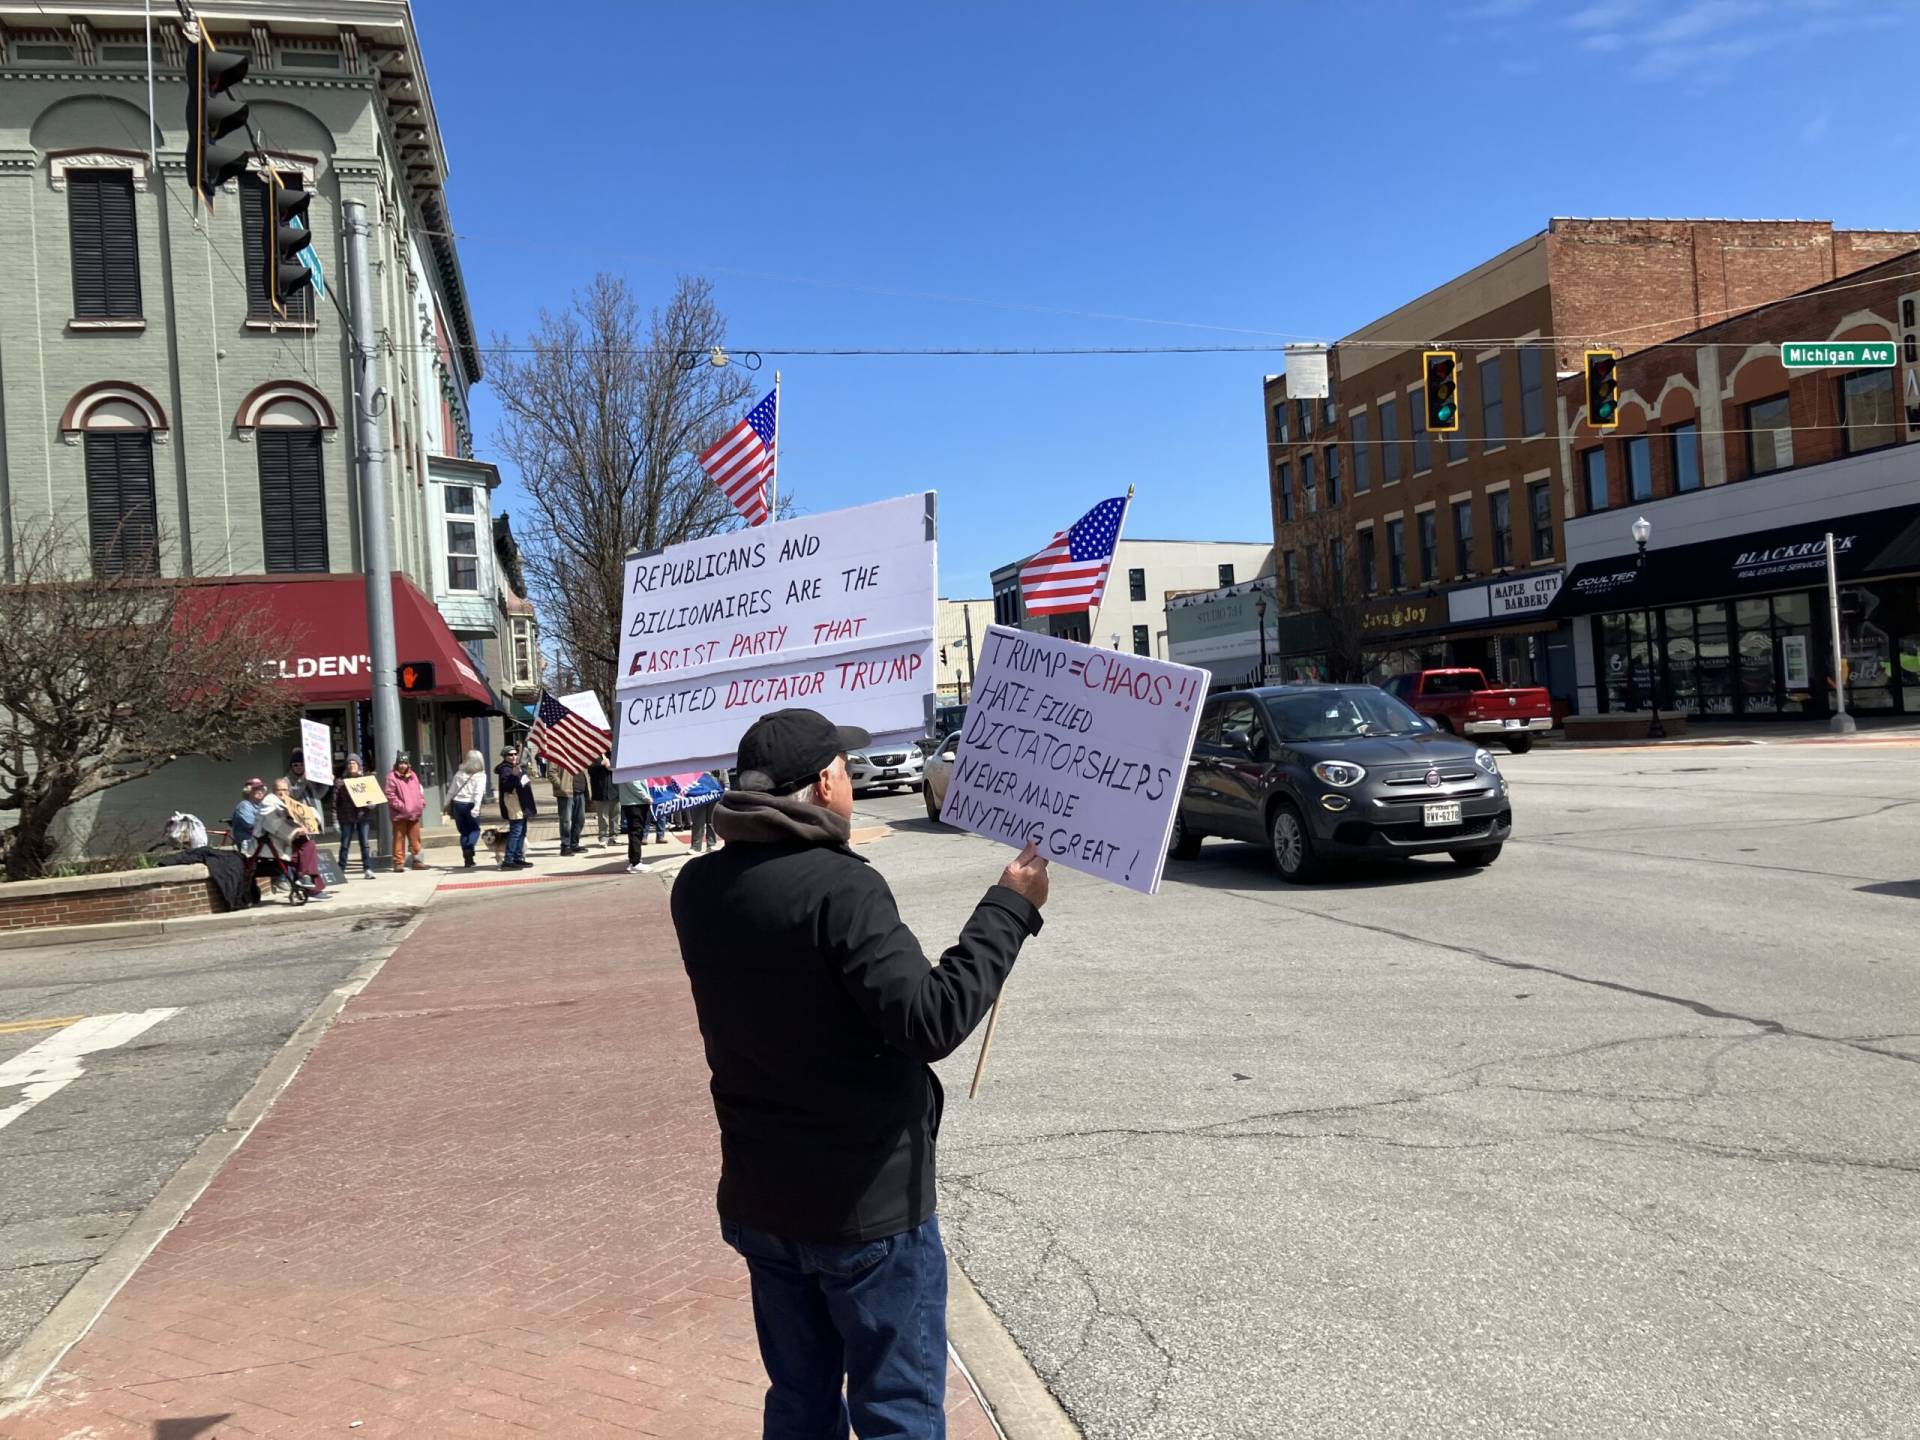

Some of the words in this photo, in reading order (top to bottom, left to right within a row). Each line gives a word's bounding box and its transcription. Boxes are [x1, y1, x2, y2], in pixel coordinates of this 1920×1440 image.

[1790, 348, 1854, 365] Michigan
[1862, 348, 1888, 361] Ave
[633, 543, 766, 594] REPUBLICANS
[779, 534, 820, 563] AND
[1495, 583, 1525, 598] MAPLE
[1534, 577, 1558, 592] CITY
[1577, 571, 1637, 587] COULTER
[629, 589, 772, 637] BILLIONAIRES
[785, 578, 822, 604] ARE
[842, 566, 880, 592] THE
[1362, 613, 1389, 629] Java
[1404, 607, 1427, 623] Joy
[1505, 593, 1549, 610] BARBERS
[629, 641, 720, 676] FASCIST
[729, 625, 788, 657] PARTY
[813, 618, 867, 645] THAT
[628, 686, 716, 726] CREATED
[724, 671, 825, 710] DICTATOR
[835, 653, 922, 691] TRUMP
[976, 675, 1035, 713] HATE
[1034, 694, 1093, 733] FILLED
[965, 711, 1171, 800] DICTATORSHIPS
[655, 798, 680, 816] FIGHT
[955, 755, 1018, 796] NEVER
[1019, 781, 1080, 817] MADE
